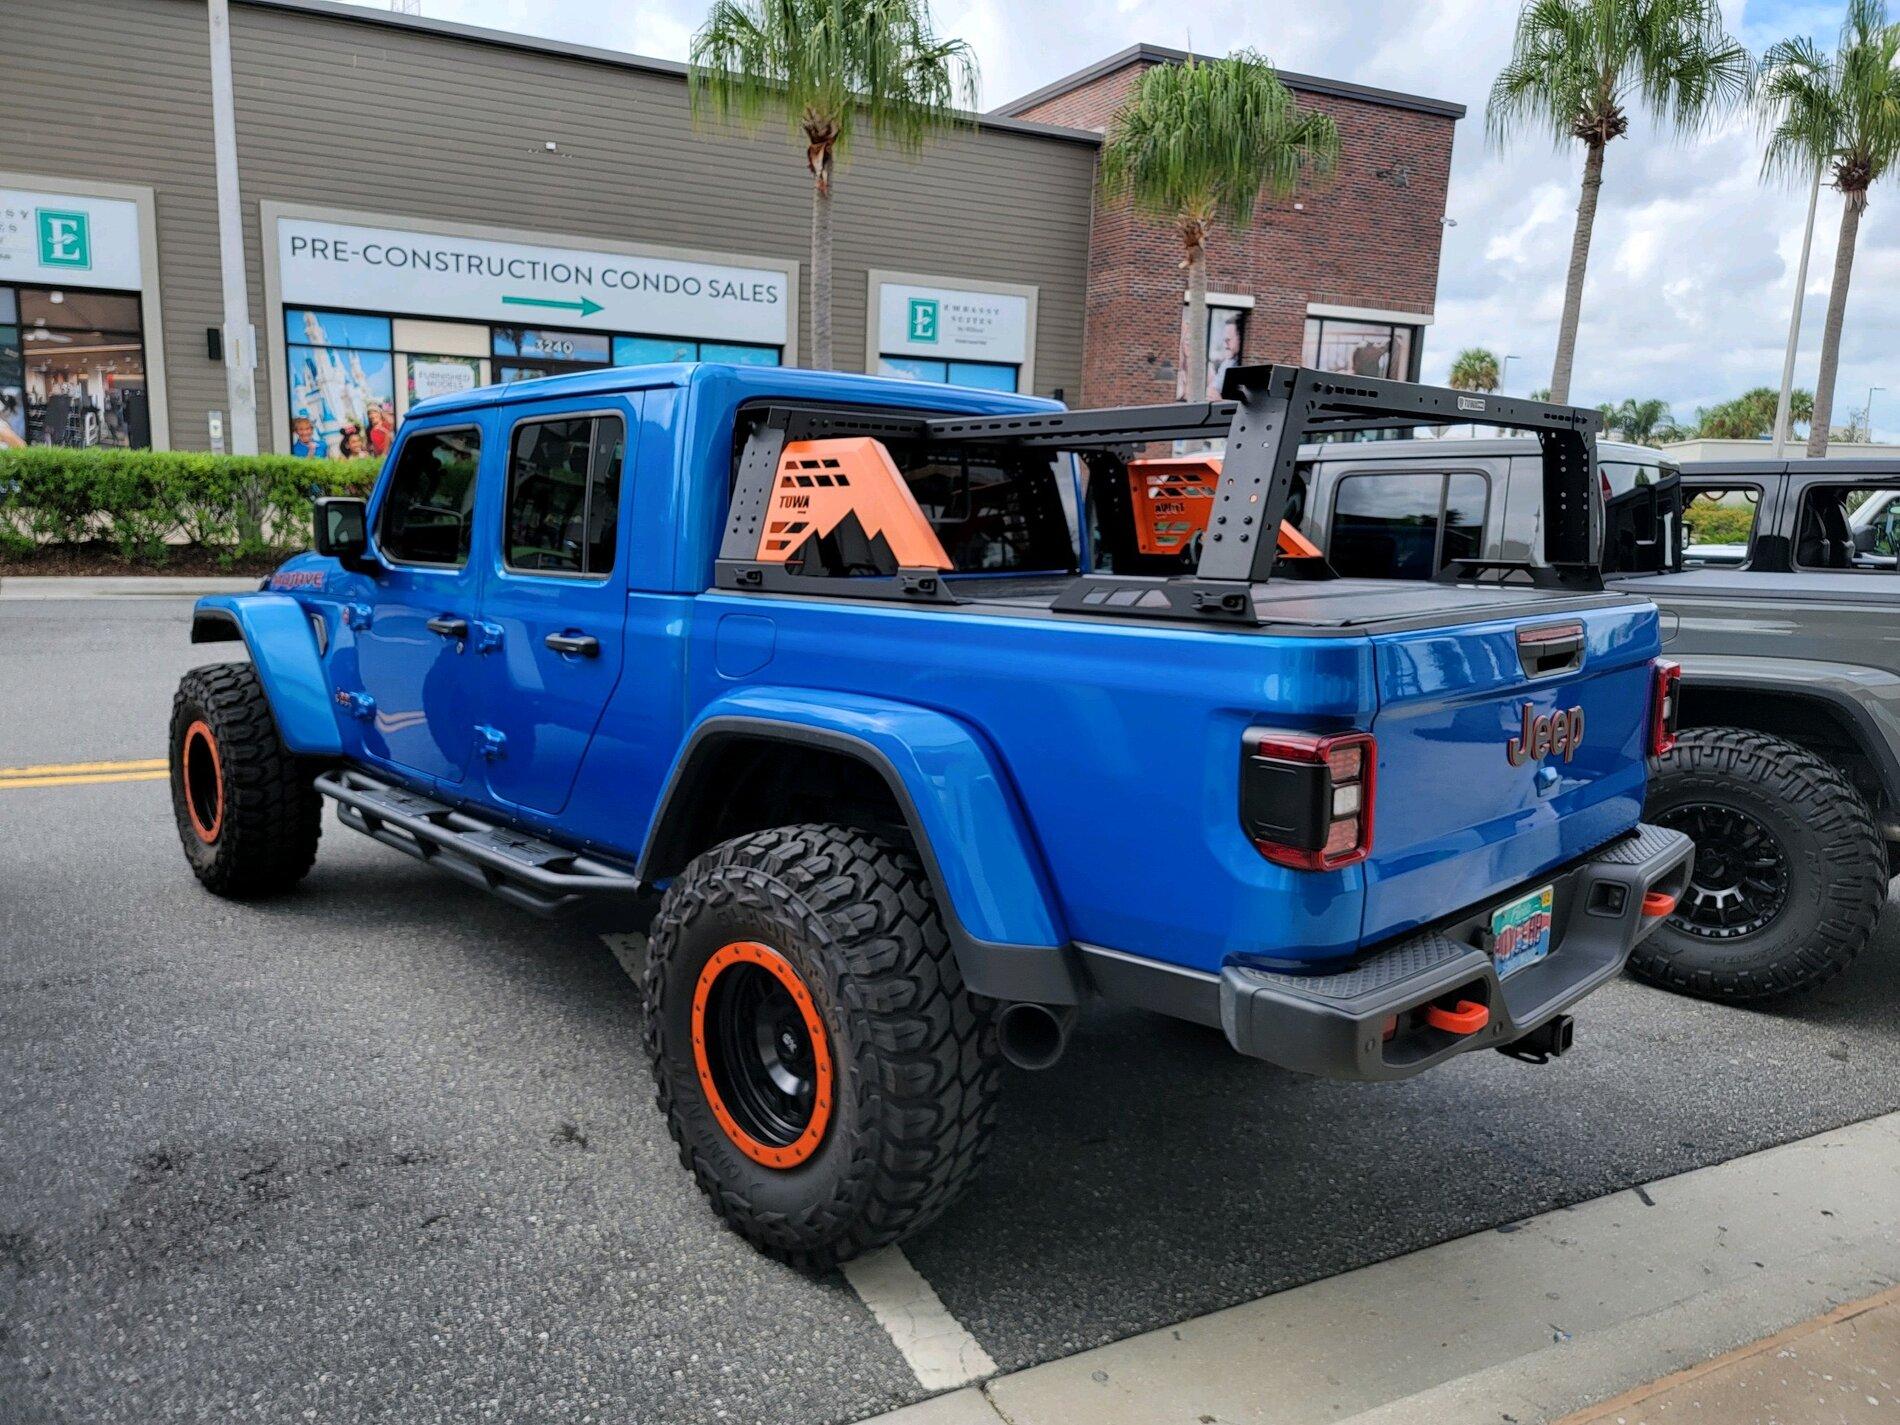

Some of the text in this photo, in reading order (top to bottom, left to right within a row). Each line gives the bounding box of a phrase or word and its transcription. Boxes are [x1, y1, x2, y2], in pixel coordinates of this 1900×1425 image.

[290, 236, 779, 304] PRE-CONSTRUCTION CONDO SALES
[779, 494, 811, 509] TUWA
[1506, 702, 1585, 767] Jeep
